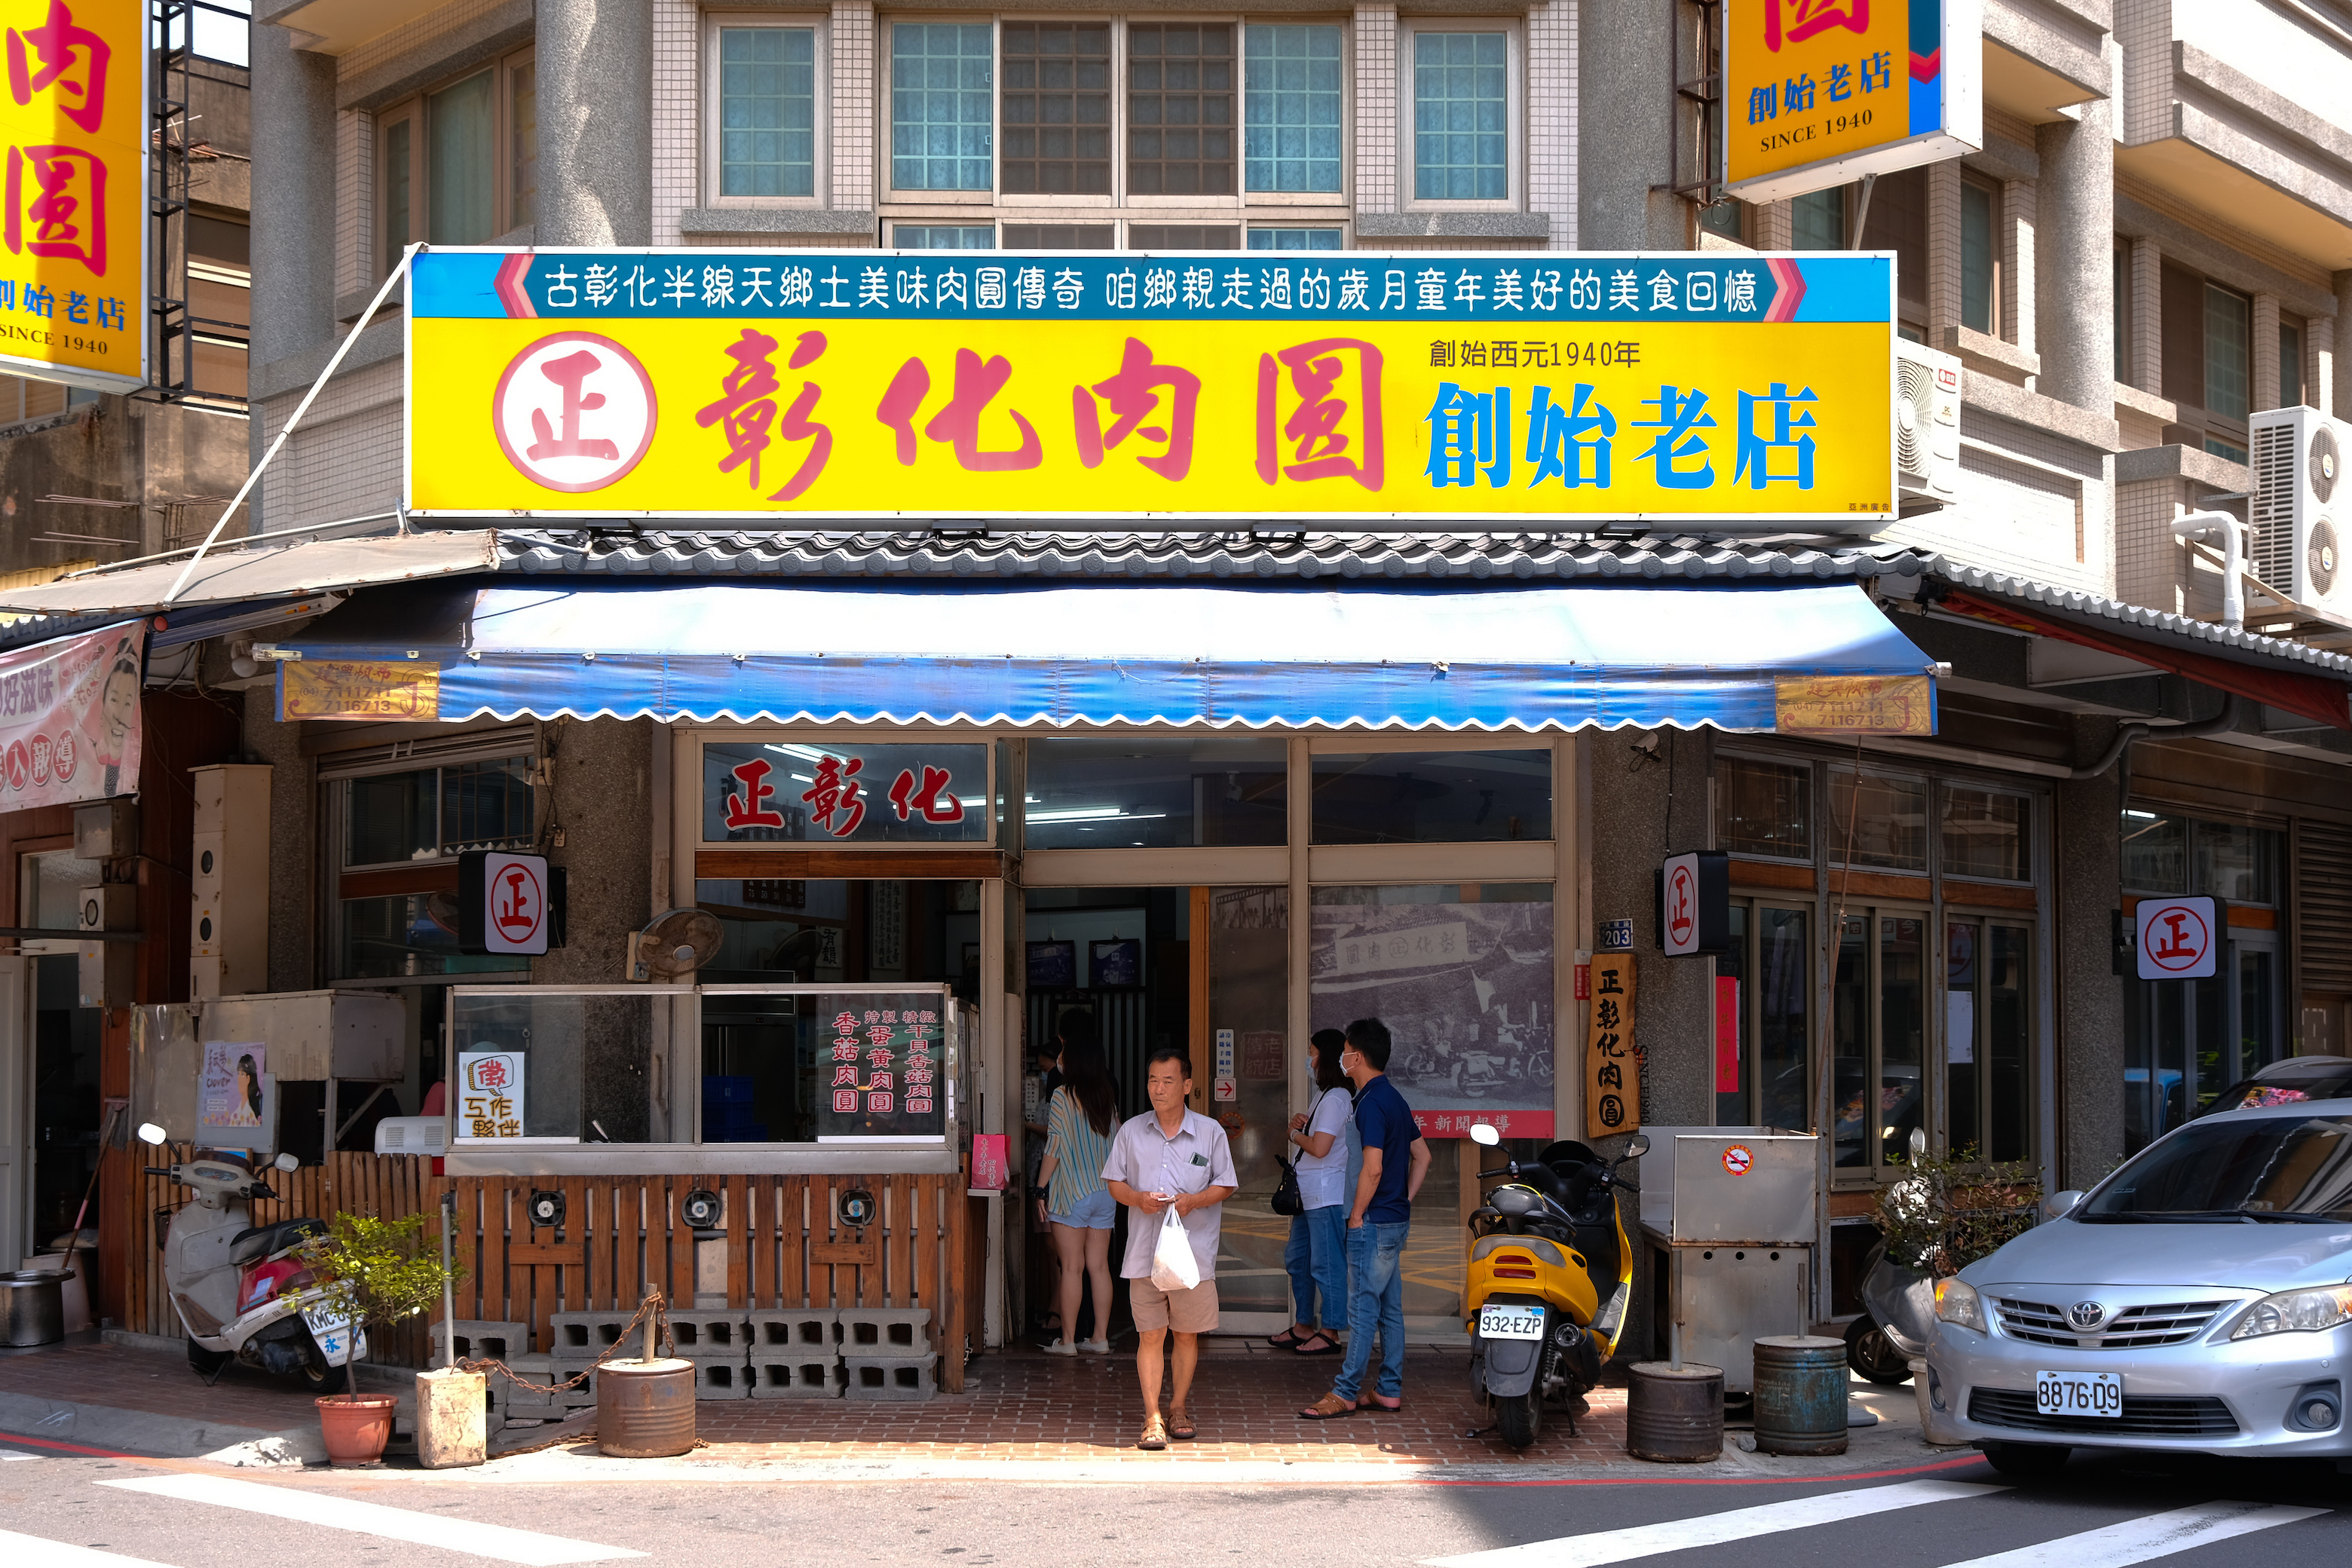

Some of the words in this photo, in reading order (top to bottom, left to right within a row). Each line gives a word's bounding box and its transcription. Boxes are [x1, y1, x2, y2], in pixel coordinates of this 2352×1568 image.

[1747, 51, 1891, 125] 創始老店
[1761, 124, 1816, 152] SINCE
[1826, 109, 1873, 136] 1940
[544, 264, 1085, 311] 古彰化半線天鄉土美味肉圓傳奇
[0, 323, 54, 346] SINCE
[63, 335, 108, 354] 1940
[1430, 339, 1641, 369] 創始西元1940年
[526, 349, 620, 462] 正
[695, 329, 1385, 502] 彰化肉圓
[1423, 381, 1820, 490] 創始老店
[1848, 503, 1890, 511] 亞洲廣告
[0, 663, 54, 717] 好滋味
[300, 686, 319, 697] (04)
[324, 700, 390, 712] 7116713
[1818, 715, 1885, 726] 7116713
[724, 755, 966, 838] 正彰化
[499, 872, 533, 929] 正
[1672, 874, 1691, 933] 正
[1606, 929, 1631, 945] 203
[2155, 914, 2197, 960] 正
[864, 1010, 898, 1024] 特製
[902, 1010, 936, 1024] 精緻
[831, 1011, 861, 1113] 香菇肉圓
[865, 1025, 896, 1113] 蛋黃肉圓
[904, 1024, 934, 1113] 干貝香菇肉圓
[1597, 969, 1625, 1128] 正彰化肉圓
[478, 1059, 506, 1087] 徵
[464, 1096, 513, 1119] 工作
